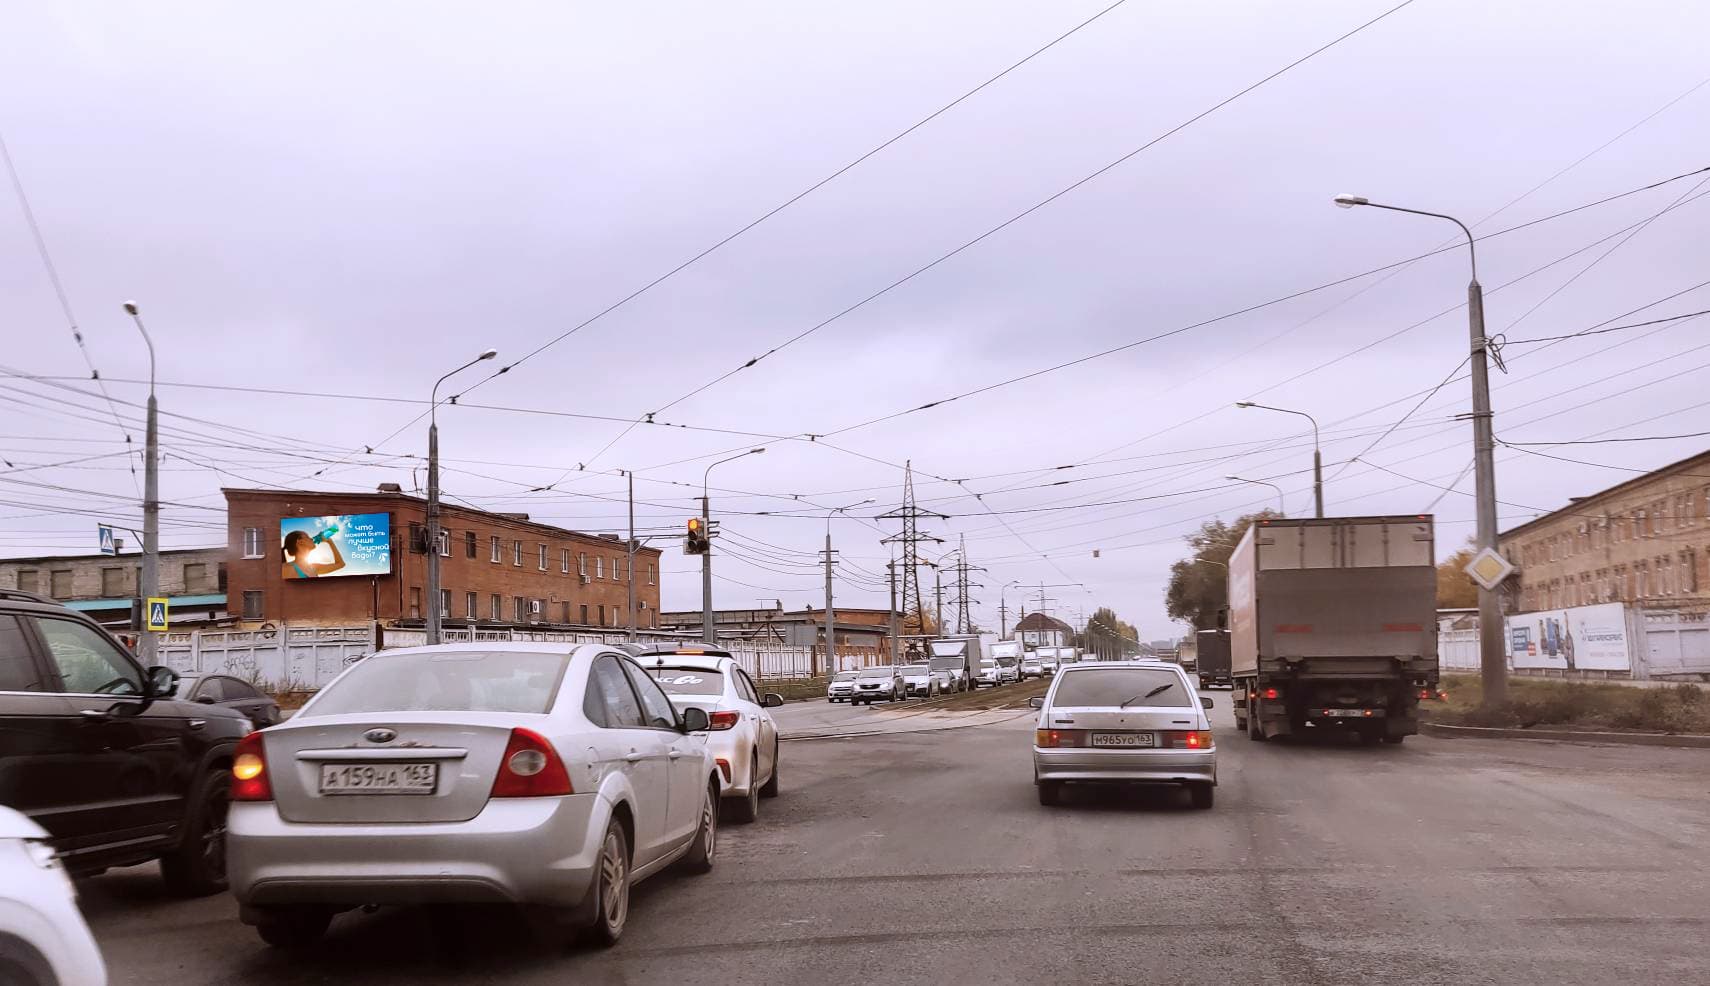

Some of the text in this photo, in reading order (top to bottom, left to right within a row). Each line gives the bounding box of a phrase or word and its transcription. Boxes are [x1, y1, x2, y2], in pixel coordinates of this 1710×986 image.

[348, 538, 374, 546] лучше
[357, 544, 390, 552] вкусной
[1095, 734, 1151, 745] М965УО 163
[326, 764, 432, 787] А159НА 163
